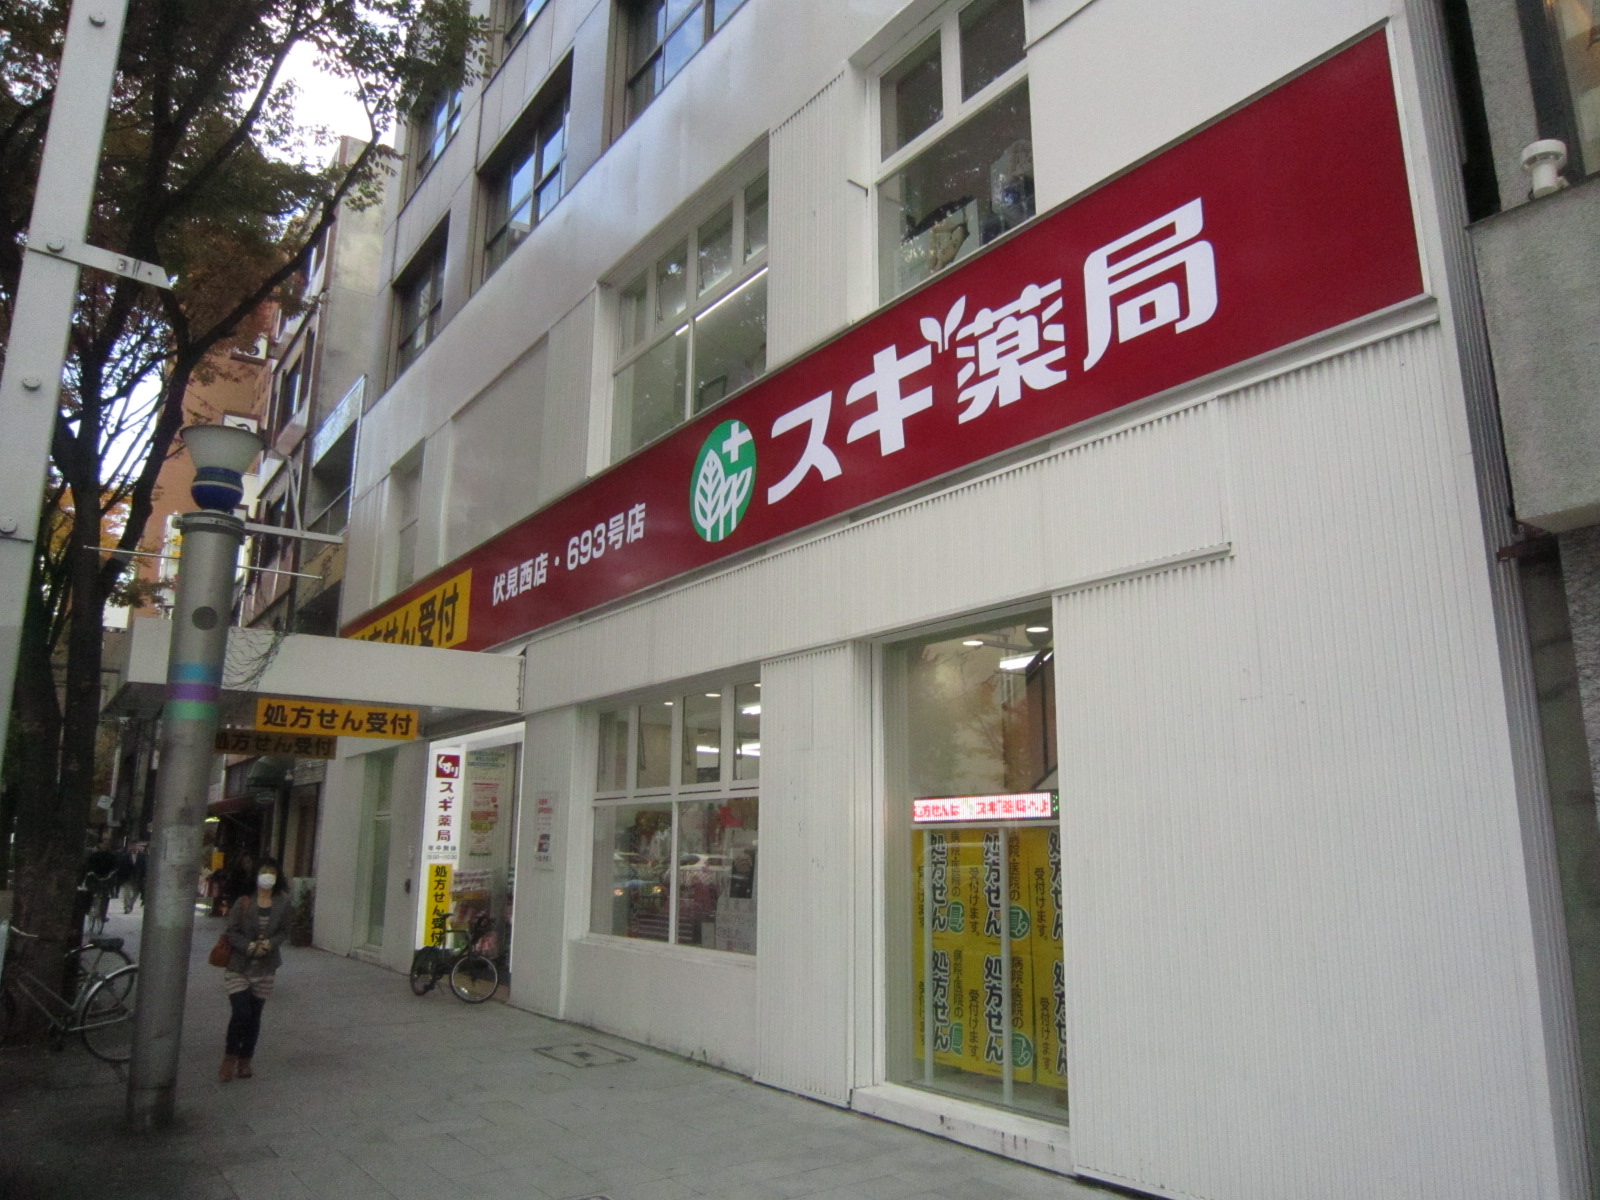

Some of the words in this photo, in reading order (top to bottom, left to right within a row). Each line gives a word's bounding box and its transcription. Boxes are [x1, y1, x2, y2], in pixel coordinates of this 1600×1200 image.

[768, 197, 1218, 505] スギ薬局
[262, 703, 412, 736] 処方せん受付
[437, 755, 458, 777] くすり
[437, 781, 455, 843] スギ薬局
